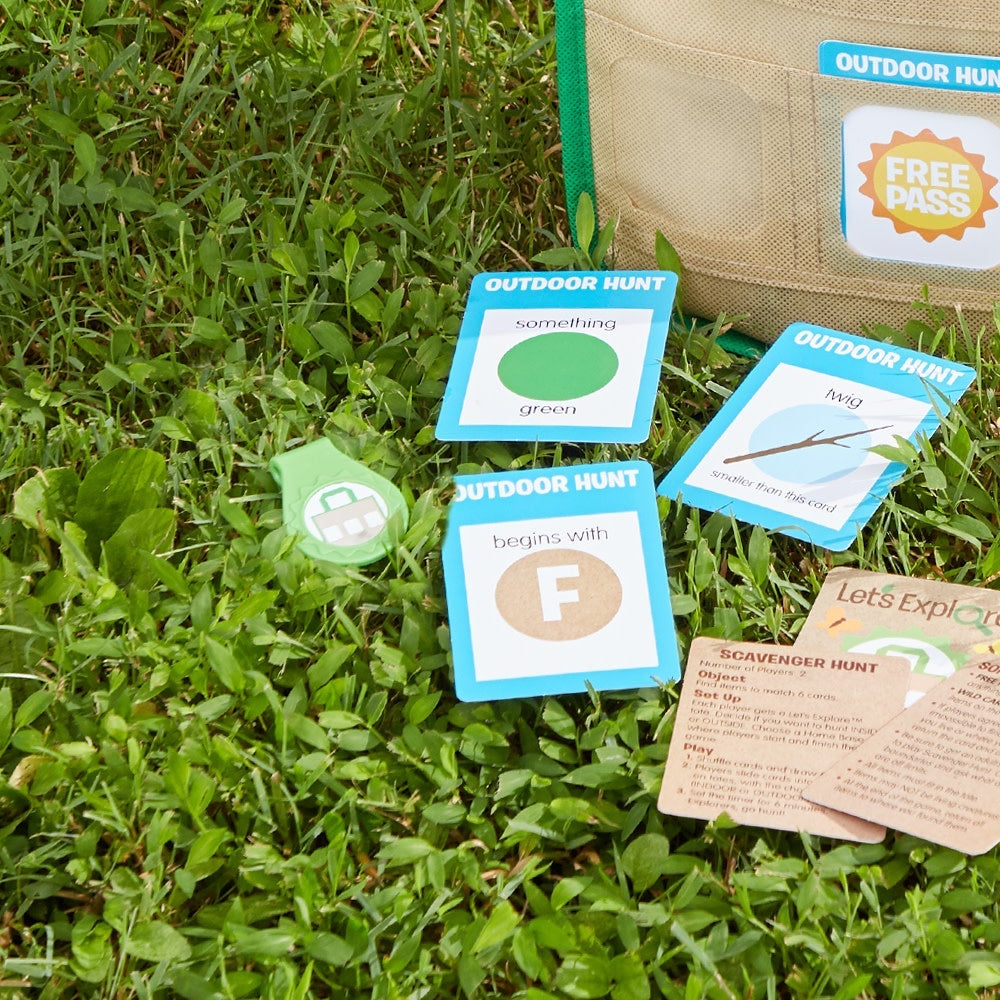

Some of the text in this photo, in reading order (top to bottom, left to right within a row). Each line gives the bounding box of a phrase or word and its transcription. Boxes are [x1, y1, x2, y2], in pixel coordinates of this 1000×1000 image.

[836, 52, 949, 83] OUTDOOR
[886, 156, 970, 189] FREE
[886, 185, 971, 218] PASS
[485, 276, 666, 291] OUTDOOR HUNT
[515, 317, 616, 331] something
[794, 330, 963, 386] OUTDOOR HUNT
[519, 404, 577, 416] green
[824, 387, 863, 410] twig
[455, 469, 639, 502] OUTDOOR HUNT
[711, 469, 838, 514] smaller than this card
[493, 526, 608, 550] begins with
[536, 564, 580, 622] F
[836, 582, 895, 609] Let's
[699, 660, 742, 670] Number
[719, 648, 878, 673] SCAVENGER HUNT
[697, 670, 746, 683] Object
[693, 688, 742, 704] Set Up
[682, 742, 714, 756] Play
